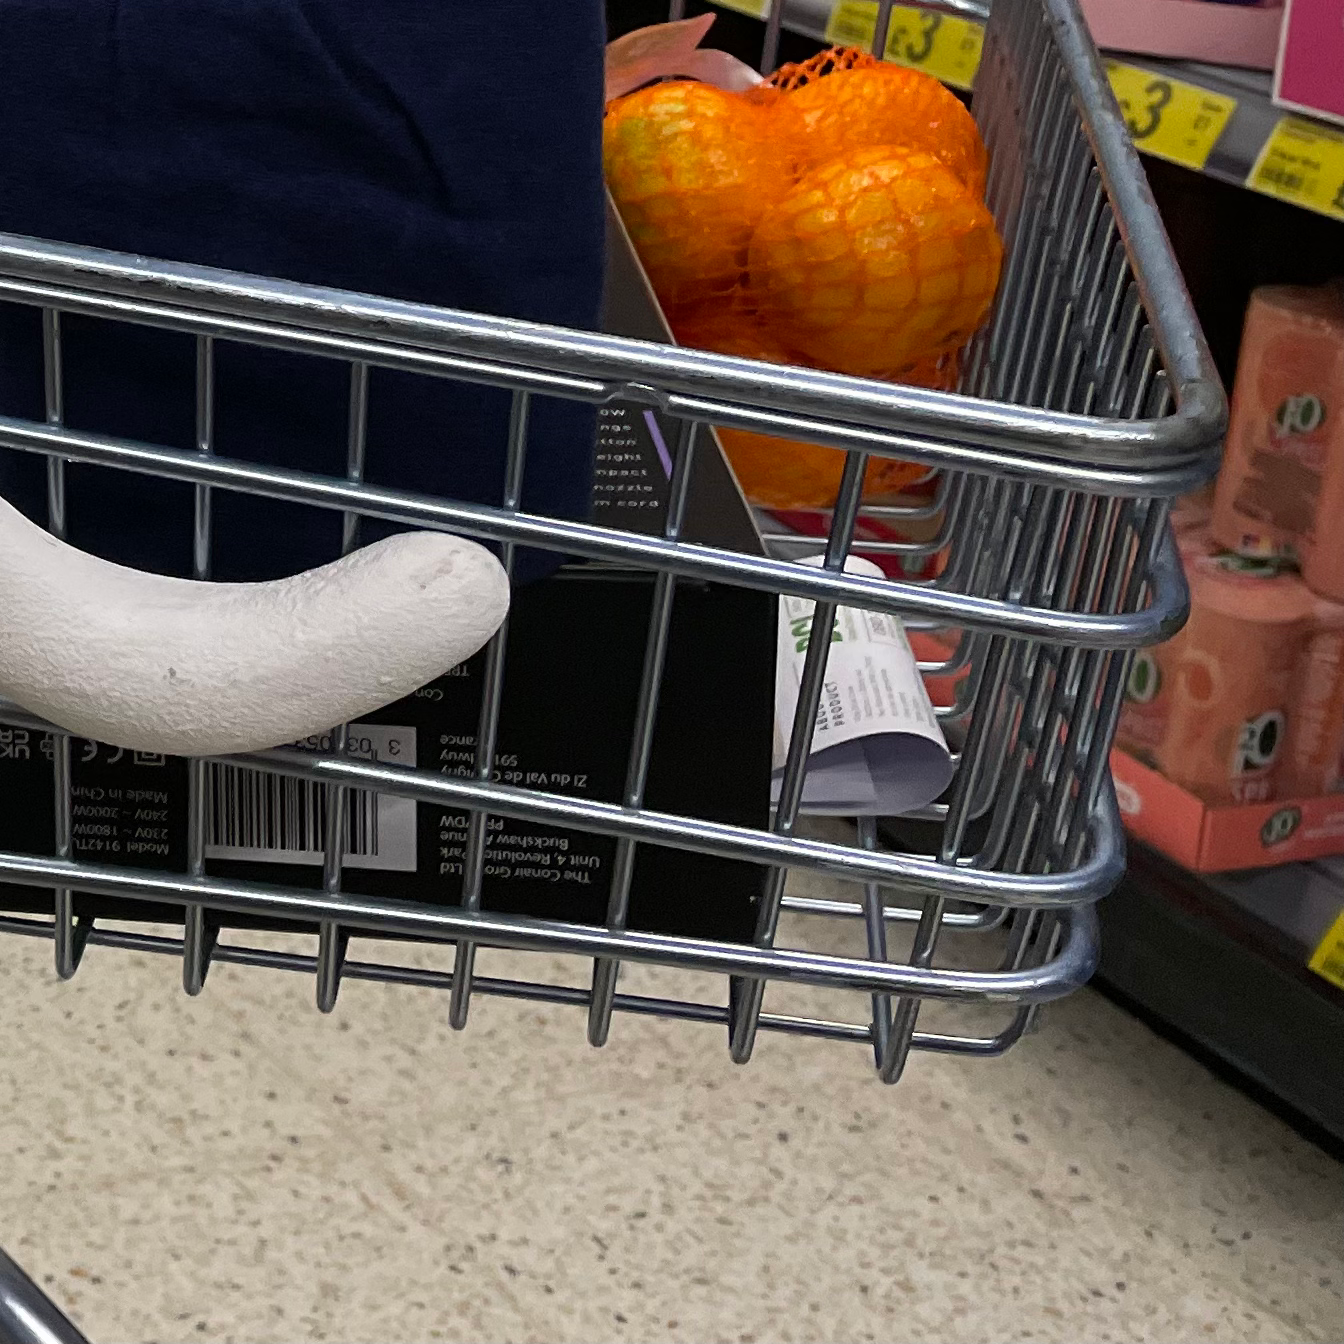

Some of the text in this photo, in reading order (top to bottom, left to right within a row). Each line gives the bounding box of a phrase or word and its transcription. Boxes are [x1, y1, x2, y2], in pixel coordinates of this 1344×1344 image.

[0, 743, 31, 760] UK
[504, 768, 523, 783] de
[525, 770, 549, 785] Val
[550, 773, 571, 787] du
[70, 786, 169, 804] Made in Chin
[72, 804, 119, 818] 2000W
[72, 822, 118, 836] 1800W
[126, 840, 170, 856] Model
[496, 834, 569, 850] Buckshaw
[439, 862, 463, 876] Ltd
[570, 854, 601, 869] Unit
[513, 867, 562, 883] Conair
[564, 869, 593, 885] The
